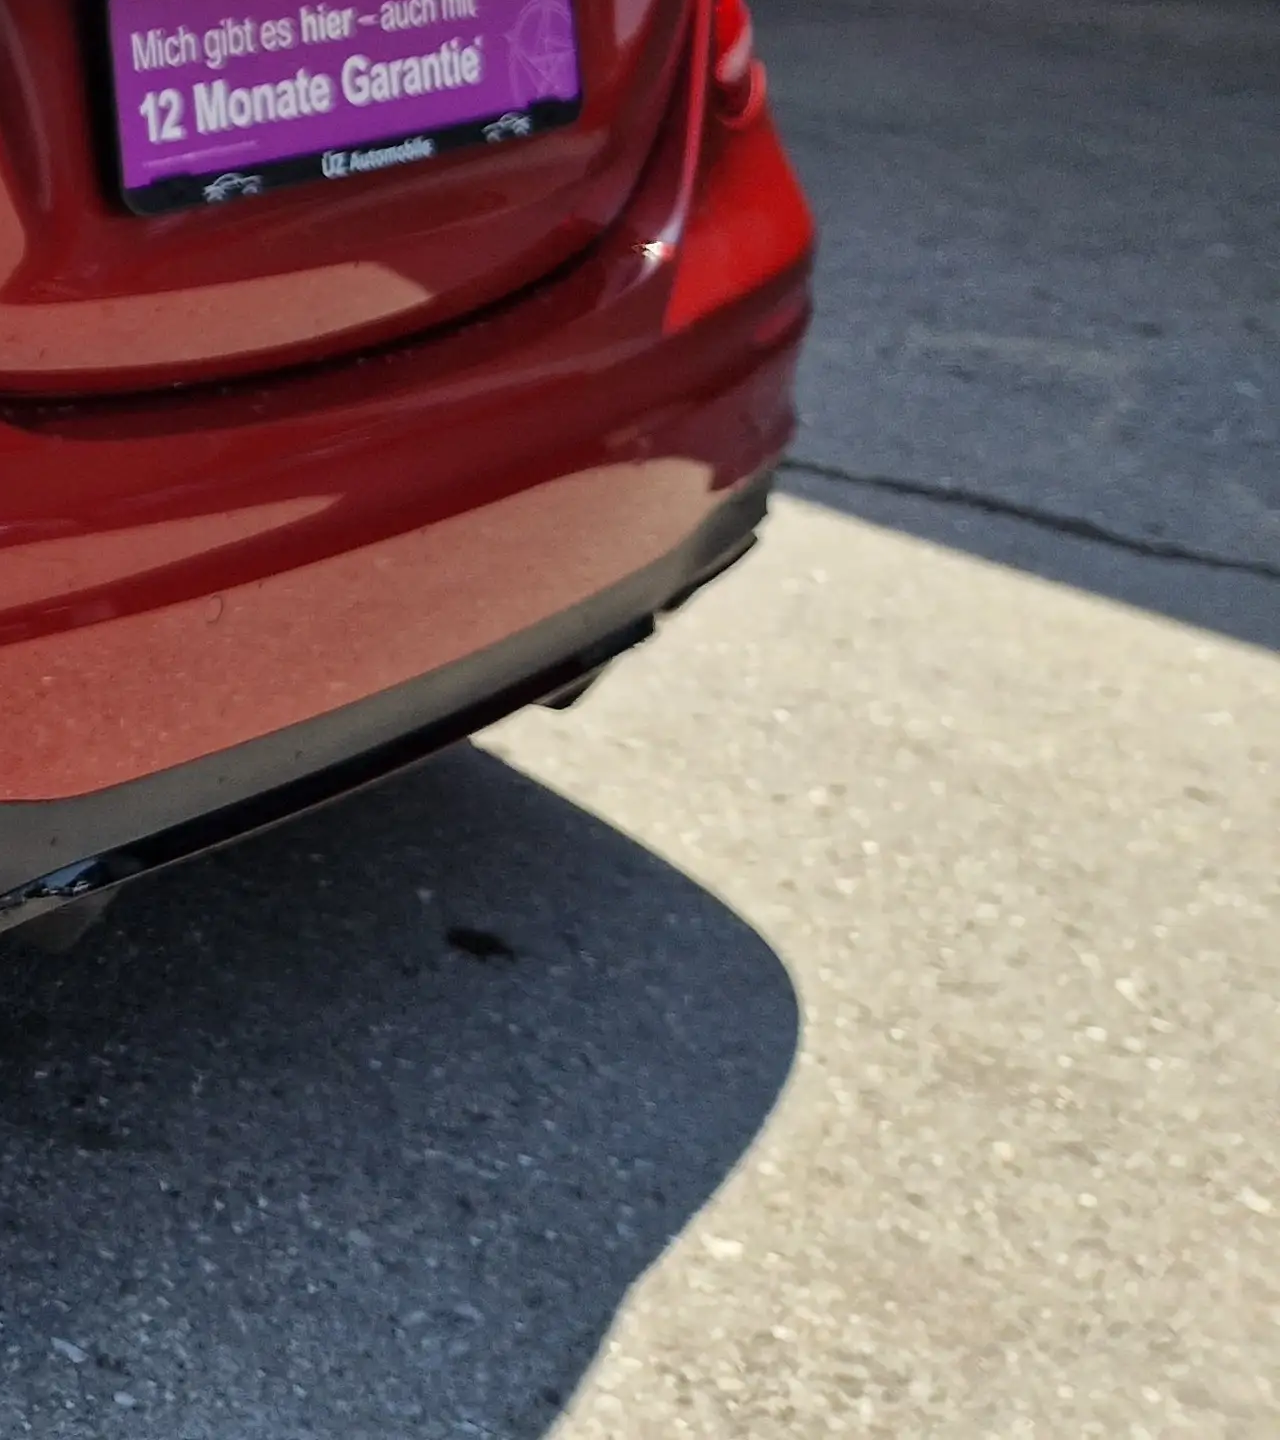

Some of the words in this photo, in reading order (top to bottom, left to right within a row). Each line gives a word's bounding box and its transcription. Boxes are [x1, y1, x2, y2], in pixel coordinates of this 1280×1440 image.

[130, 25, 200, 72] Mich
[203, 17, 258, 70] gibt
[260, 16, 298, 52] es
[299, 2, 357, 44] hier
[139, 87, 187, 145] 12
[193, 67, 337, 136] Monate
